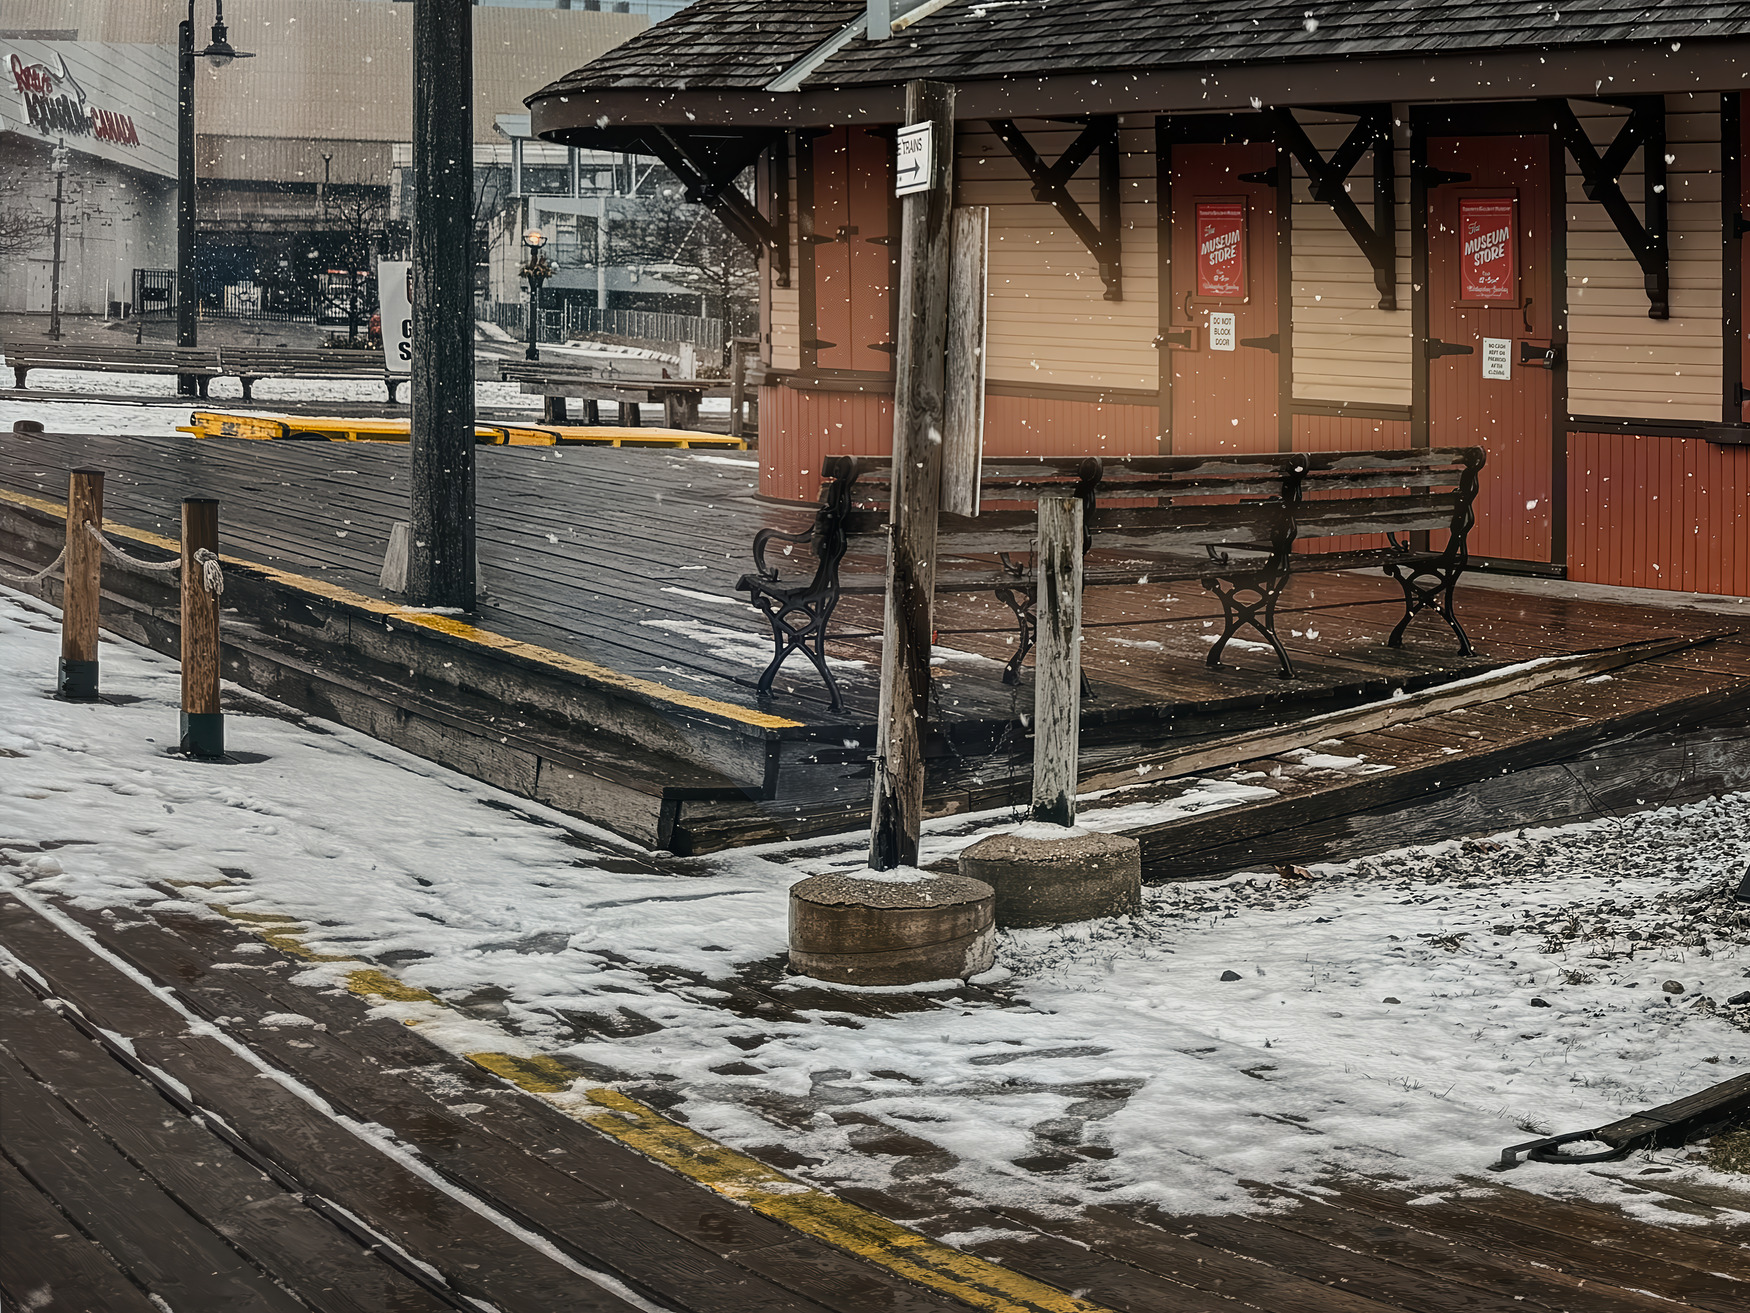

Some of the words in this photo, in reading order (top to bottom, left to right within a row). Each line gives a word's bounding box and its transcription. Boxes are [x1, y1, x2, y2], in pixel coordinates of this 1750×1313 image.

[902, 137, 923, 156] TRAINS
[1201, 229, 1240, 255] MUSEUM
[1464, 226, 1509, 256] MUSEUM
[1209, 244, 1237, 265] STORE
[1474, 243, 1505, 267] STORE
[1213, 317, 1220, 325] DO
[1221, 317, 1232, 325] NOT
[1214, 328, 1231, 336] BLOCK
[1215, 338, 1230, 346] DOOR
